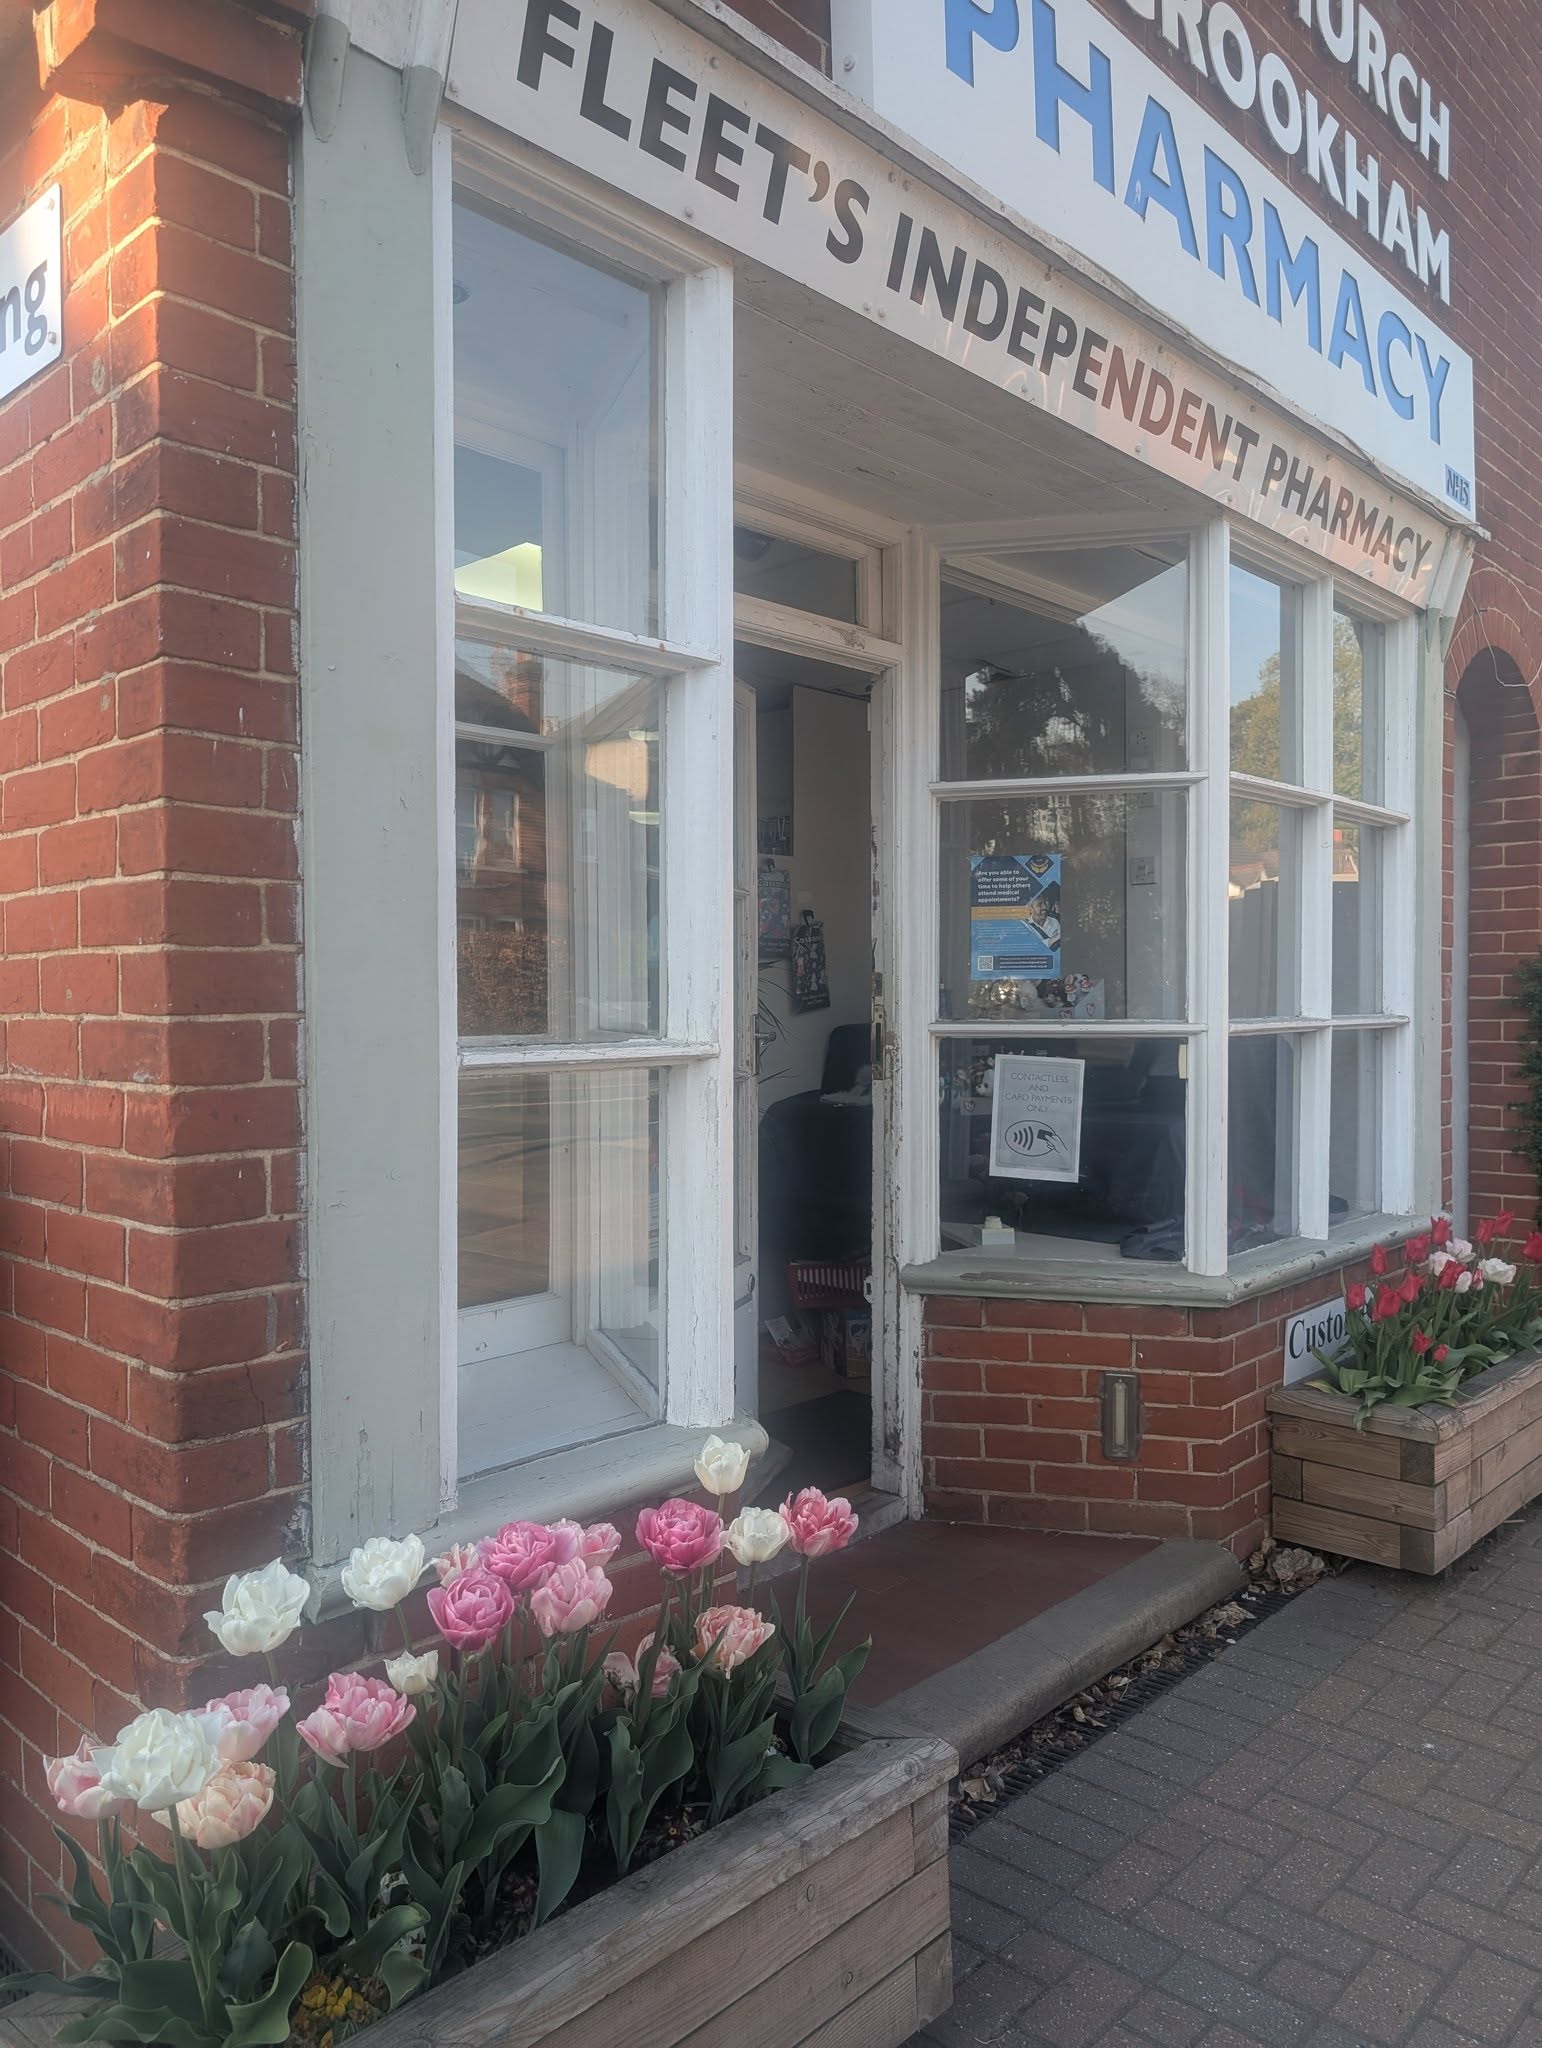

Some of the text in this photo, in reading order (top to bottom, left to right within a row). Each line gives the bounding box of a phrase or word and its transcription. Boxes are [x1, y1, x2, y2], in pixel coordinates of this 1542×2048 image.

[1299, 0, 1450, 182] URCH
[1121, 0, 1450, 306] ROOKHAM
[946, 0, 1451, 446] PHARMACY
[886, 211, 1260, 483] INDEPENDENT
[1260, 442, 1433, 580] PHARMACY
[1447, 468, 1470, 506] NHS
[1005, 1093, 1073, 1104] CARD PAYMENTS
[1010, 1072, 1069, 1083] CONTACTLESS
[1029, 1084, 1049, 1092] AND
[1026, 1104, 1049, 1113] ONLY
[1289, 1309, 1349, 1359] Custo
